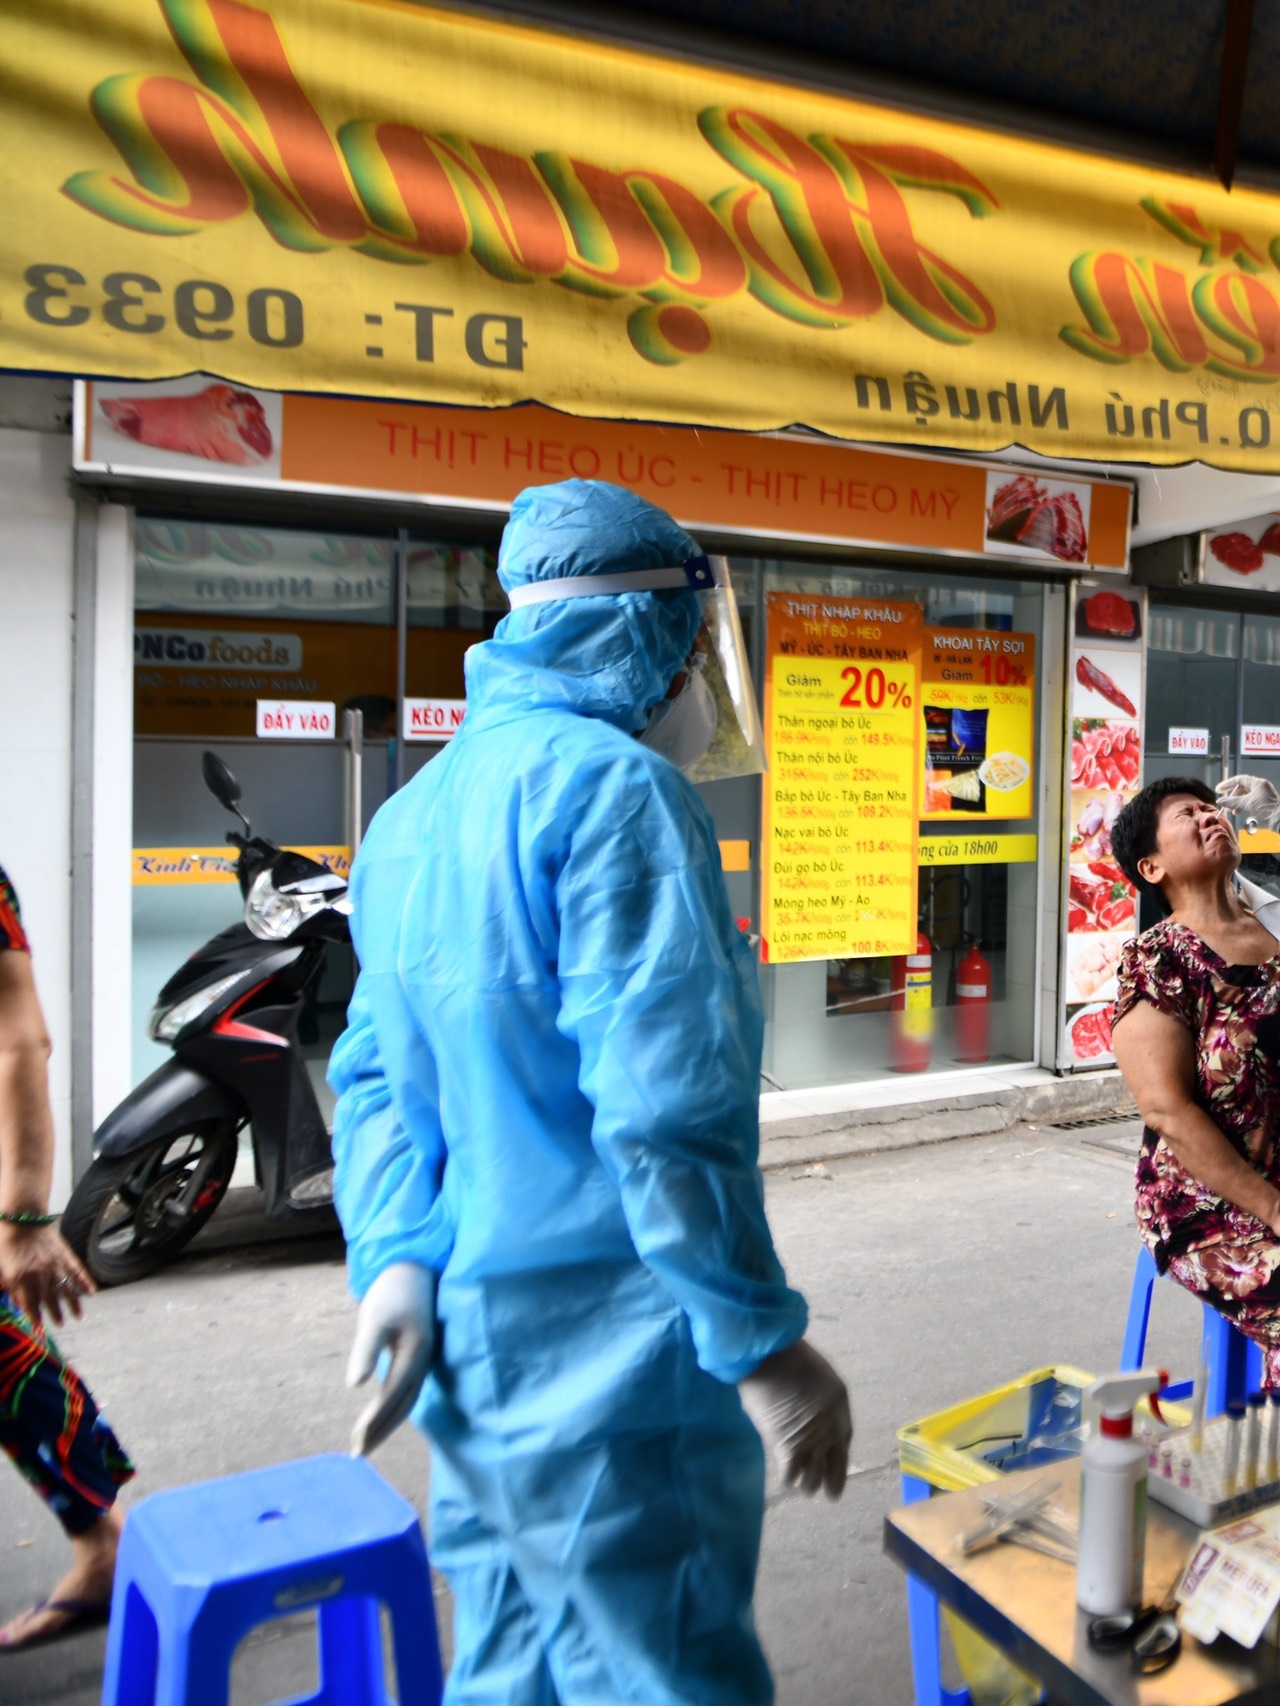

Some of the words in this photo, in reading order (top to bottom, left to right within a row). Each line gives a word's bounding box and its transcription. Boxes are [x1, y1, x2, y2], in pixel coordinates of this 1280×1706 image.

[377, 418, 489, 470] THỊT
[503, 435, 601, 478] HEO
[617, 442, 677, 488] ÚC
[720, 463, 808, 507] THỊT
[820, 477, 898, 514] HEO
[909, 488, 960, 520] MỸ
[786, 601, 819, 621] THỊT
[822, 604, 861, 623] NHẬP
[857, 626, 882, 641] HEO
[933, 635, 974, 651] KHOAI
[976, 637, 1001, 652] TÂY
[859, 647, 883, 660] BAN
[885, 649, 909, 661] NHA
[839, 665, 912, 709] 20%
[263, 704, 295, 732] ĐẨY
[299, 709, 330, 732] VÀO
[411, 703, 445, 726] KÉO
[1190, 735, 1206, 750] VÀO
[1245, 728, 1262, 746] KÉO
[863, 790, 884, 802] Ban
[886, 790, 907, 802] Nha
[918, 845, 935, 862] ng
[963, 839, 998, 856] 18h00
[807, 896, 828, 908] heo
